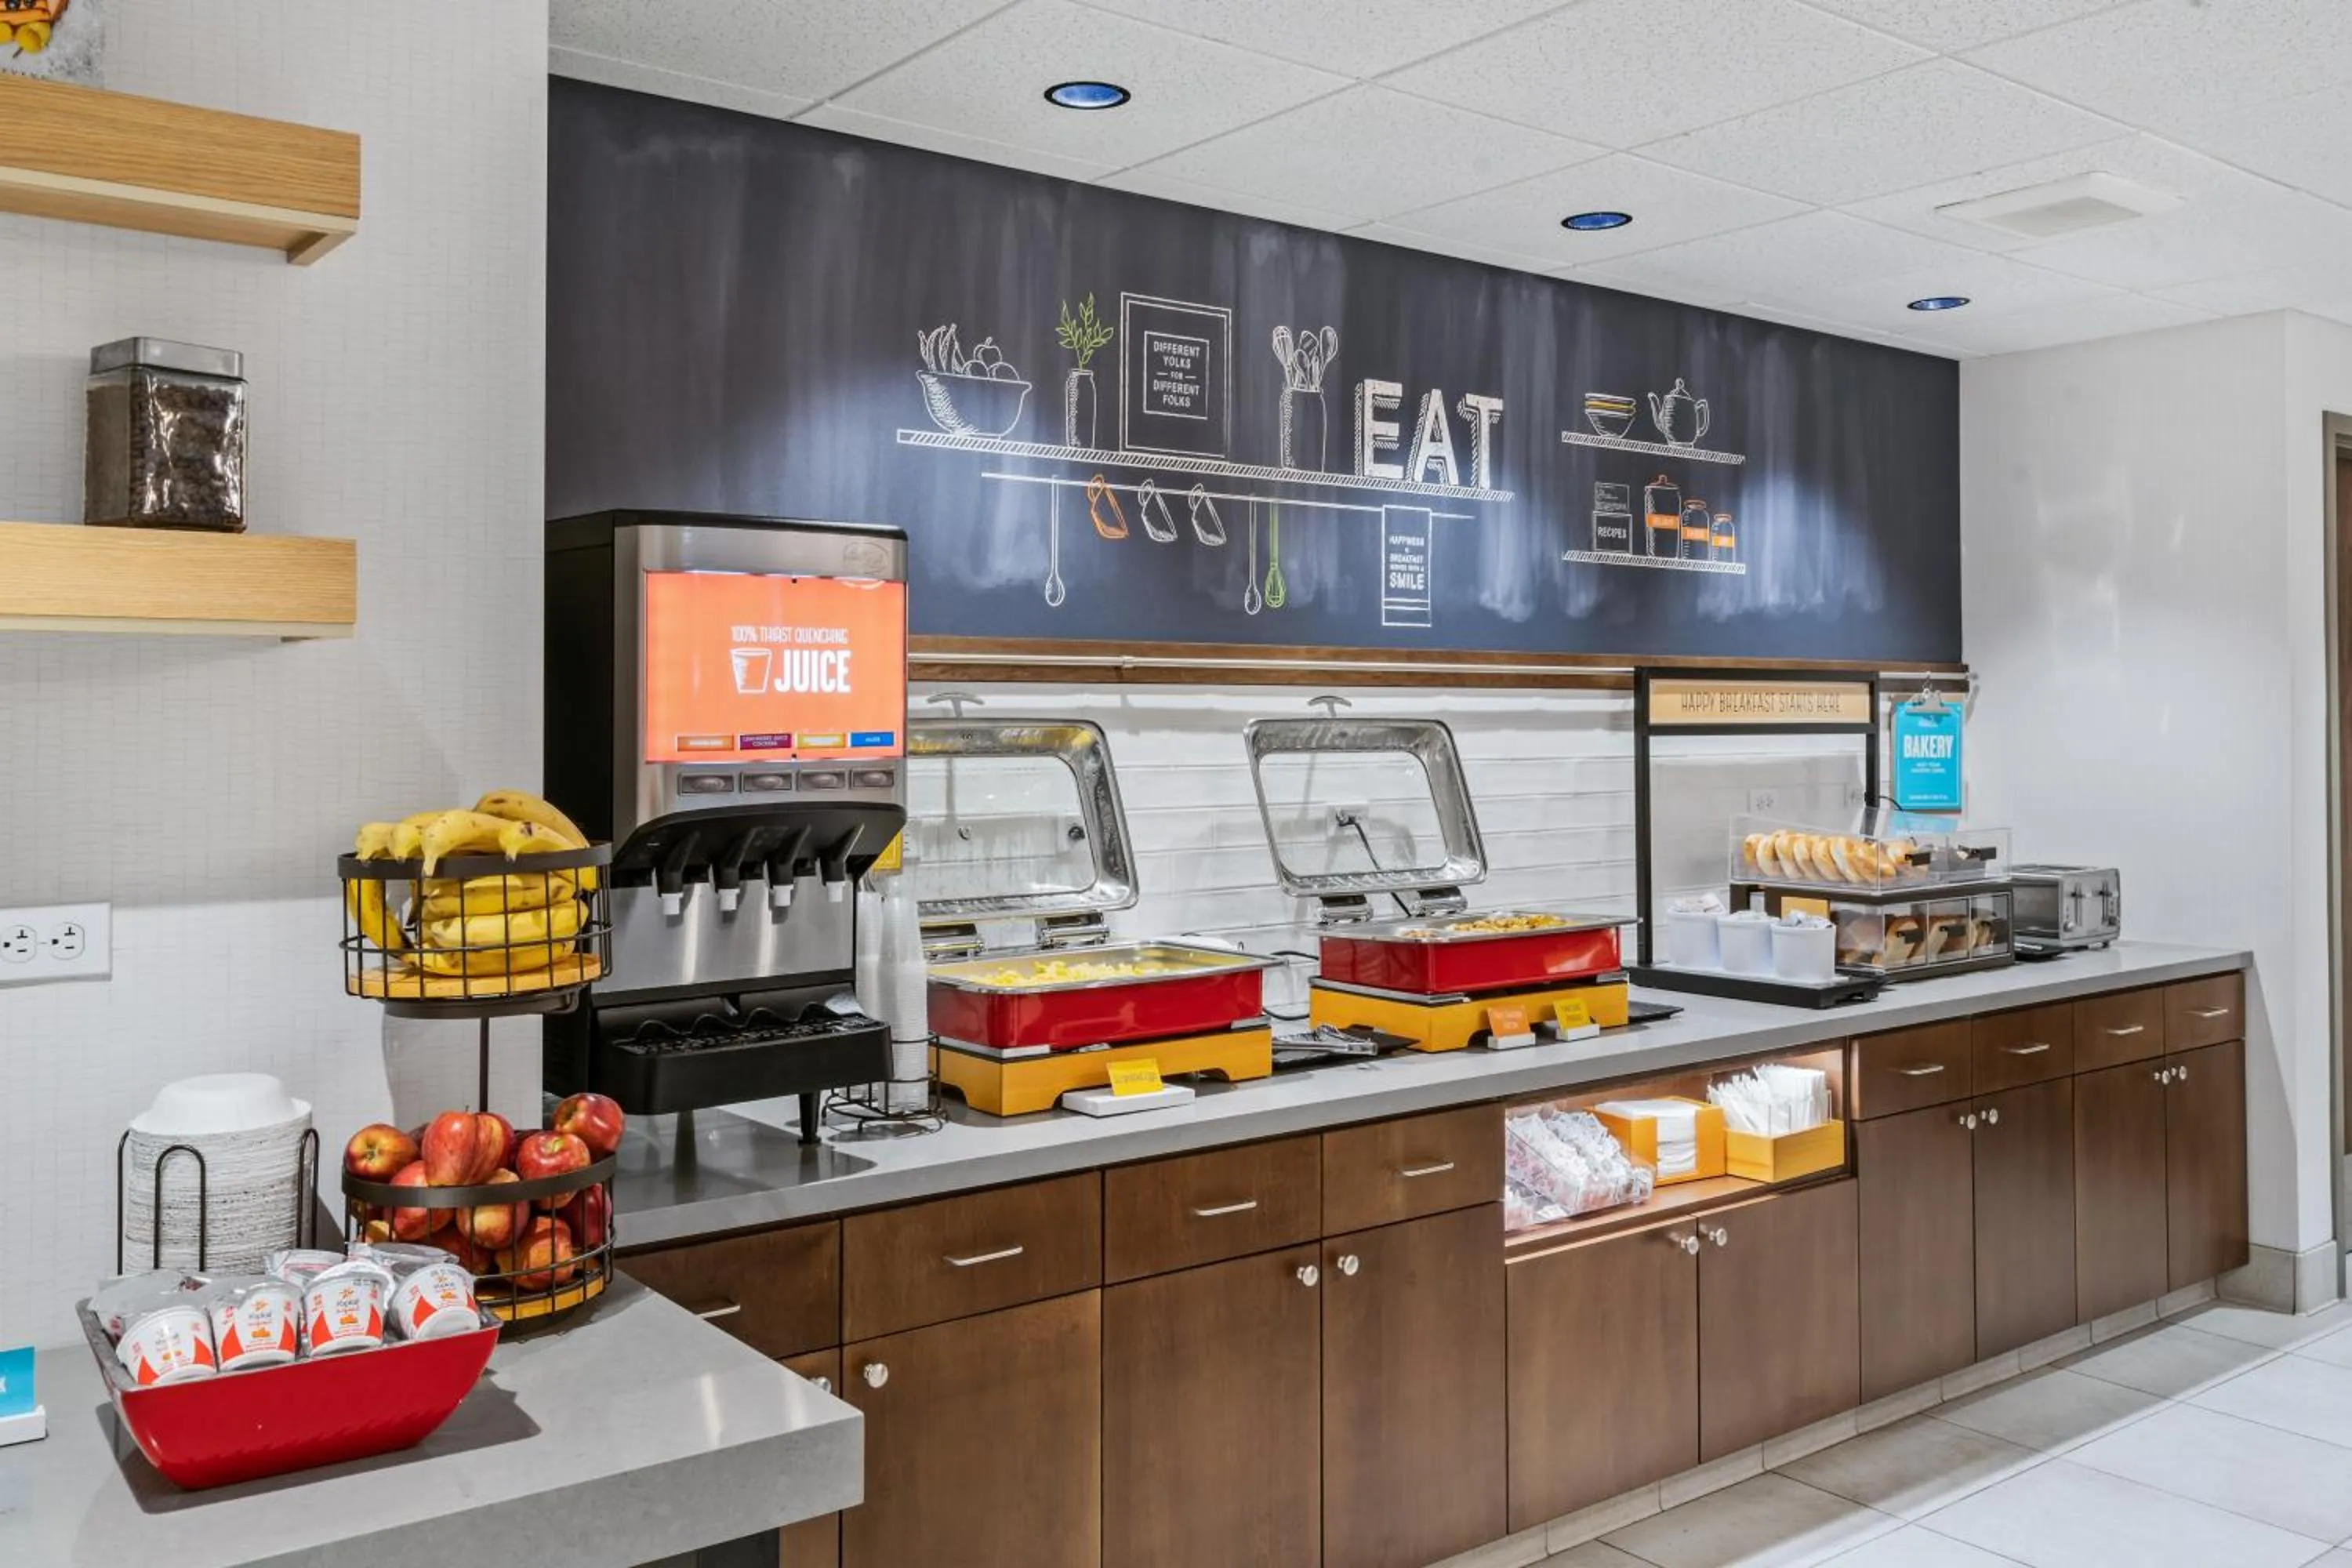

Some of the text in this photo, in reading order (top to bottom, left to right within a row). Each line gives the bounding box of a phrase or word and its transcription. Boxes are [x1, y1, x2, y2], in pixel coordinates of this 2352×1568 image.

[1153, 340, 1200, 358] DIFFERENT
[1163, 355, 1191, 369] YOLKS
[1153, 379, 1200, 396] DIFFERENT
[1163, 394, 1191, 408] FOLKS
[1355, 379, 1504, 488] EAT
[1389, 572, 1425, 590] SMILE
[731, 626, 758, 643] 100%
[774, 649, 851, 693] JUICE
[1682, 691, 1715, 713] HAPPY
[1719, 691, 1776, 713] BREAKFAST
[1779, 692, 1814, 713] STARTS
[1904, 735, 1954, 759] BAKERY
